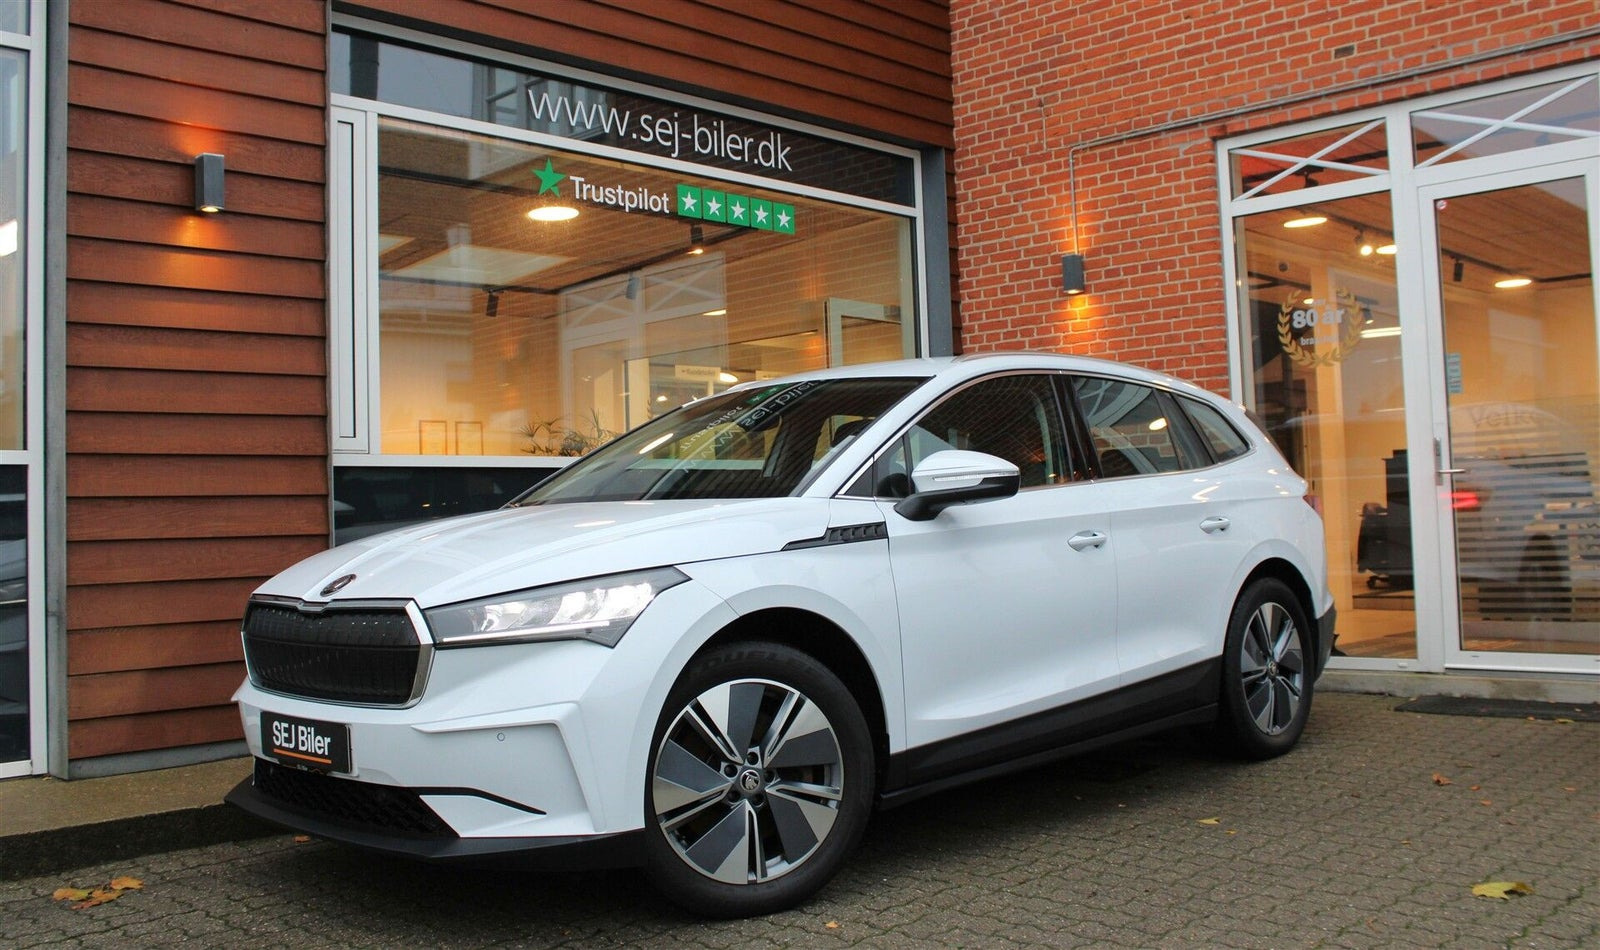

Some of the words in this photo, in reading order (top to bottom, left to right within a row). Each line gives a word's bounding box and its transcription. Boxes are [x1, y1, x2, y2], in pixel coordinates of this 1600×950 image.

[528, 89, 792, 171] www.sej-biler.dk
[569, 176, 670, 213] Trustpilot
[1292, 308, 1318, 329] 80
[272, 720, 296, 749] SEJ
[298, 725, 331, 756] Biler
